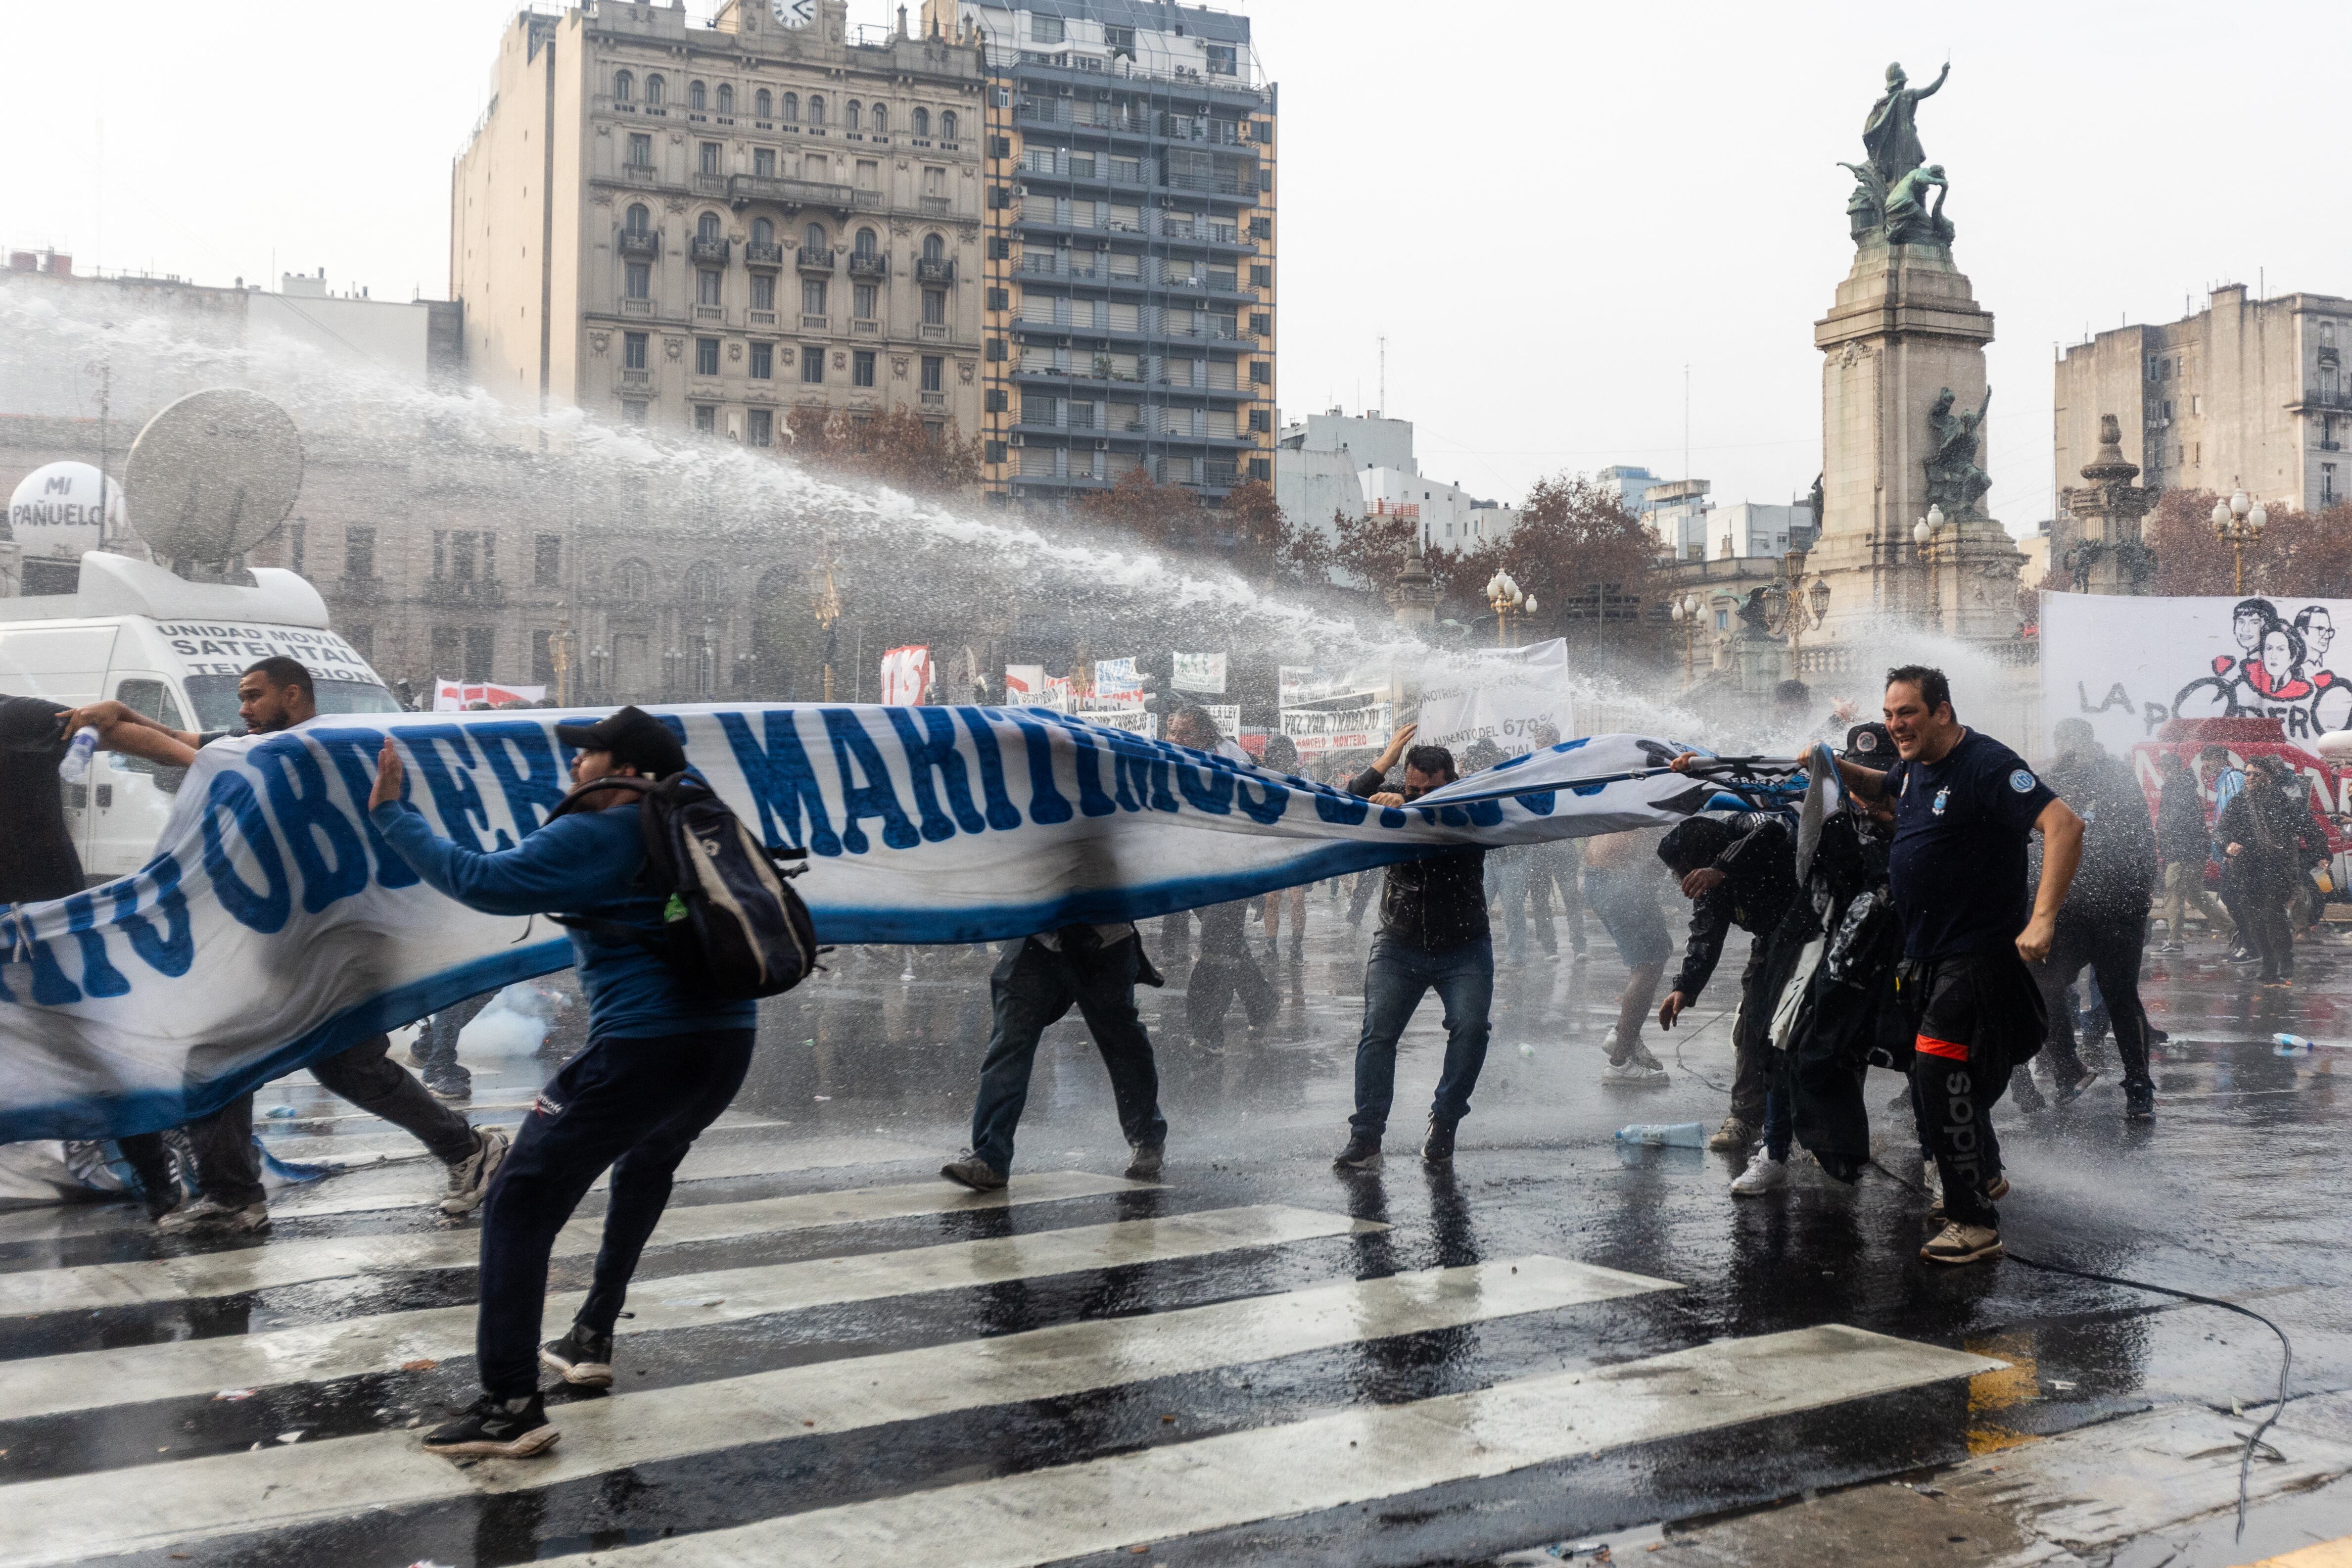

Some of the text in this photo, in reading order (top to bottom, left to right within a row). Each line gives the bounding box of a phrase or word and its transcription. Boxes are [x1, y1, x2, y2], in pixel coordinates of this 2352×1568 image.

[44, 476, 72, 495] MI
[157, 625, 348, 648] UNIDAD MOVIL
[171, 639, 363, 665] SATELITAL
[188, 663, 378, 684] TELSION
[2078, 680, 2136, 714] LA
[1295, 734, 1367, 749] MARCELO MONTERO
[1479, 725, 1499, 738] DEL
